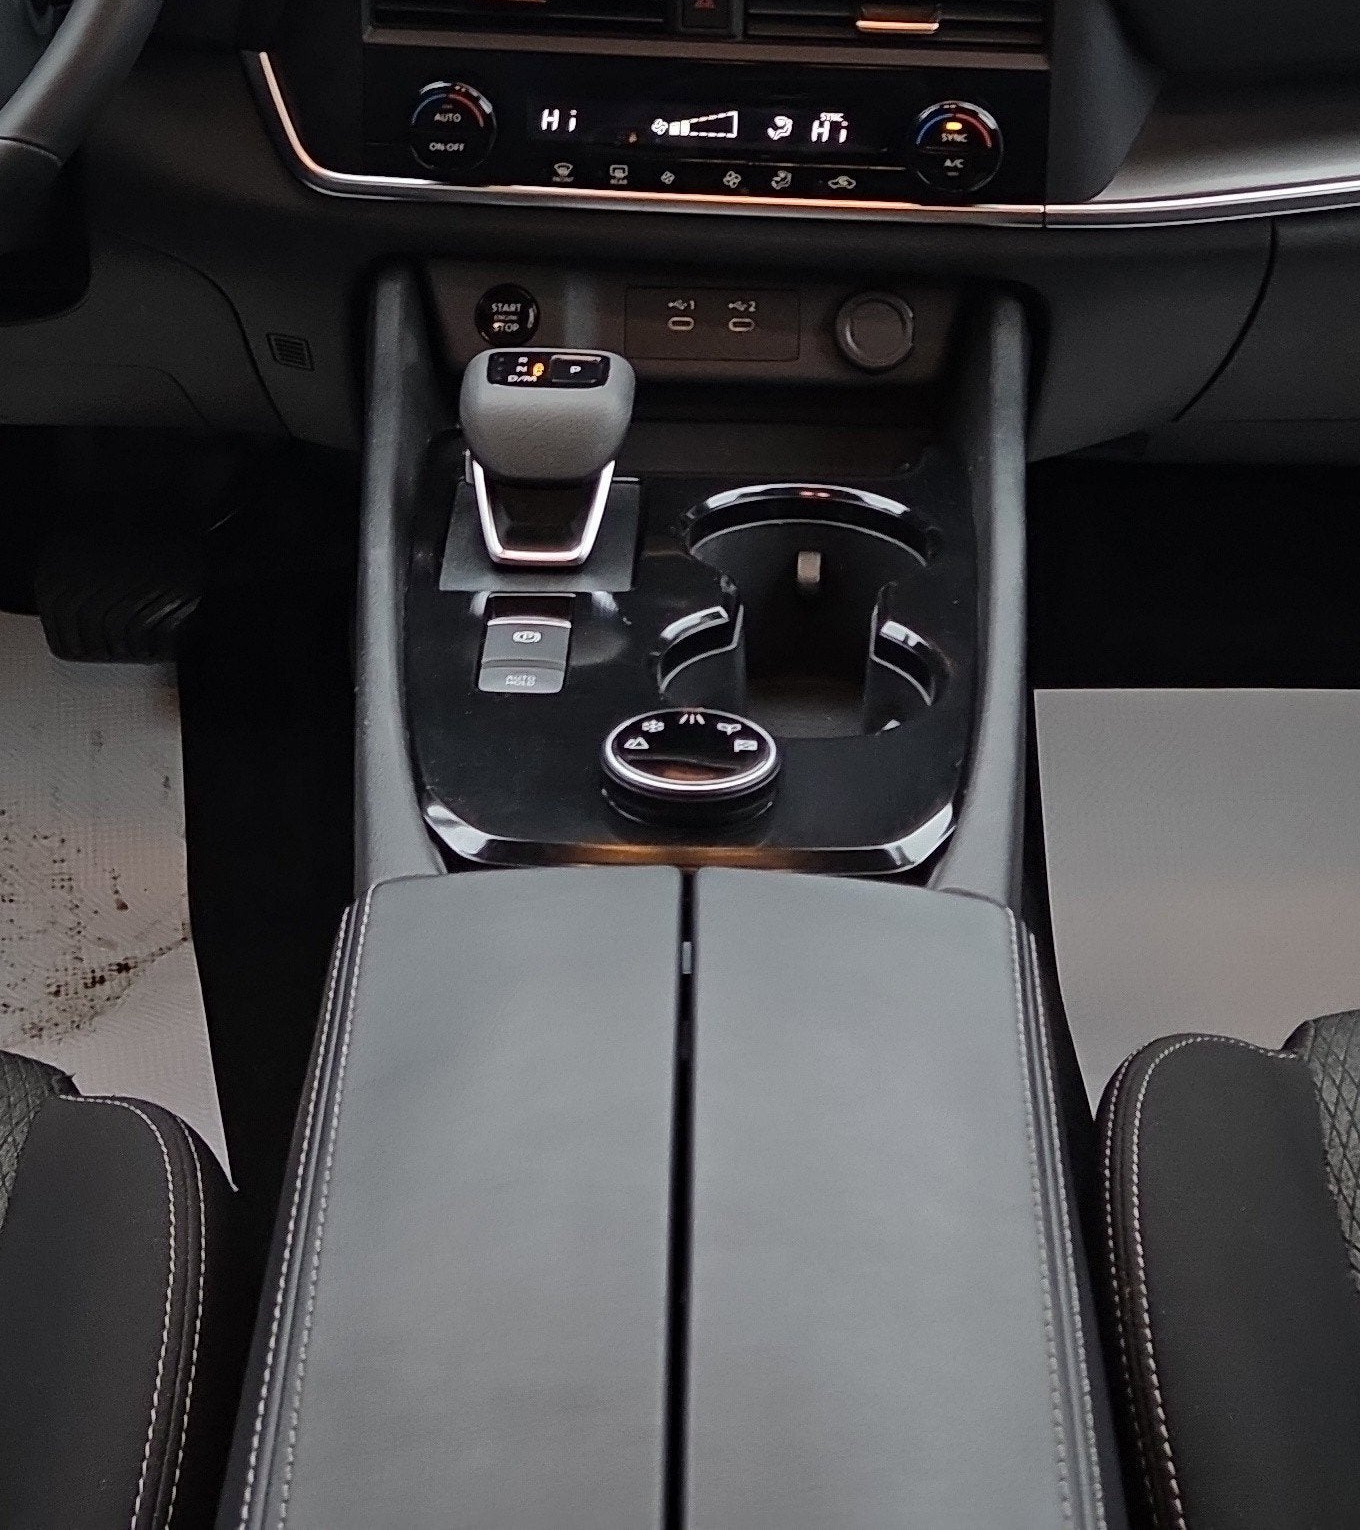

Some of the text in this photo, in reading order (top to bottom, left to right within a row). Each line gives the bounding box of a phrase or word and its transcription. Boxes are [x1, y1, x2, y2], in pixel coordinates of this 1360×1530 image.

[433, 112, 462, 123] AUTO
[941, 133, 968, 143] SYNC
[944, 158, 965, 169] A/C
[491, 302, 522, 313] START
[748, 301, 757, 312] 2
[569, 365, 582, 374] P
